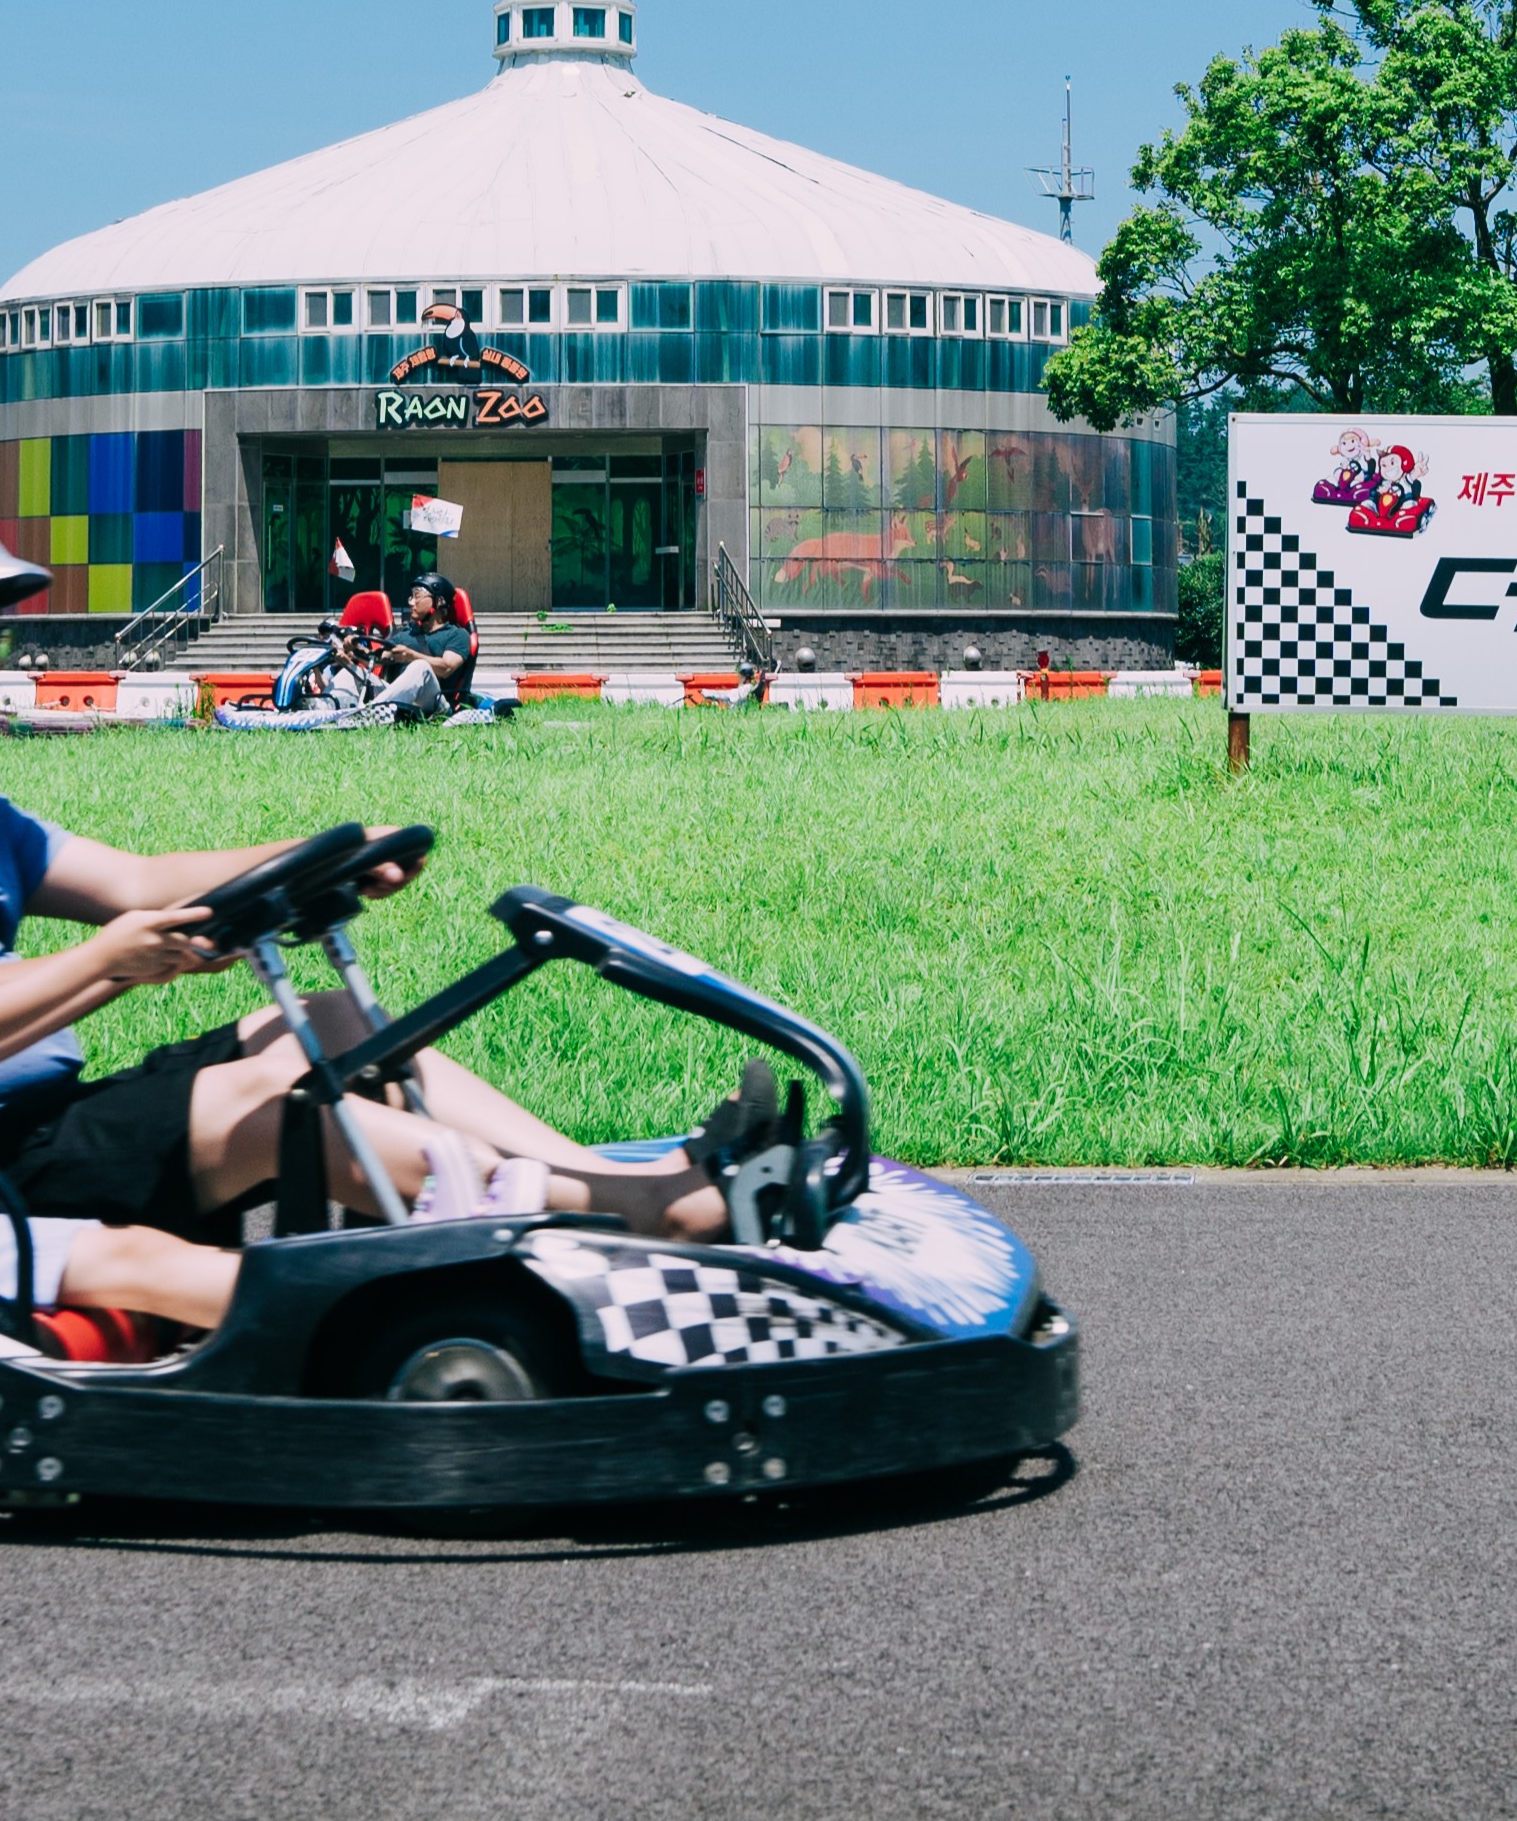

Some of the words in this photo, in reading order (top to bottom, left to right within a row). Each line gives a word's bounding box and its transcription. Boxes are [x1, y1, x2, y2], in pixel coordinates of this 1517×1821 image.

[378, 391, 466, 424] RAON
[476, 391, 546, 423] ZOO
[1457, 472, 1516, 507] 제주
